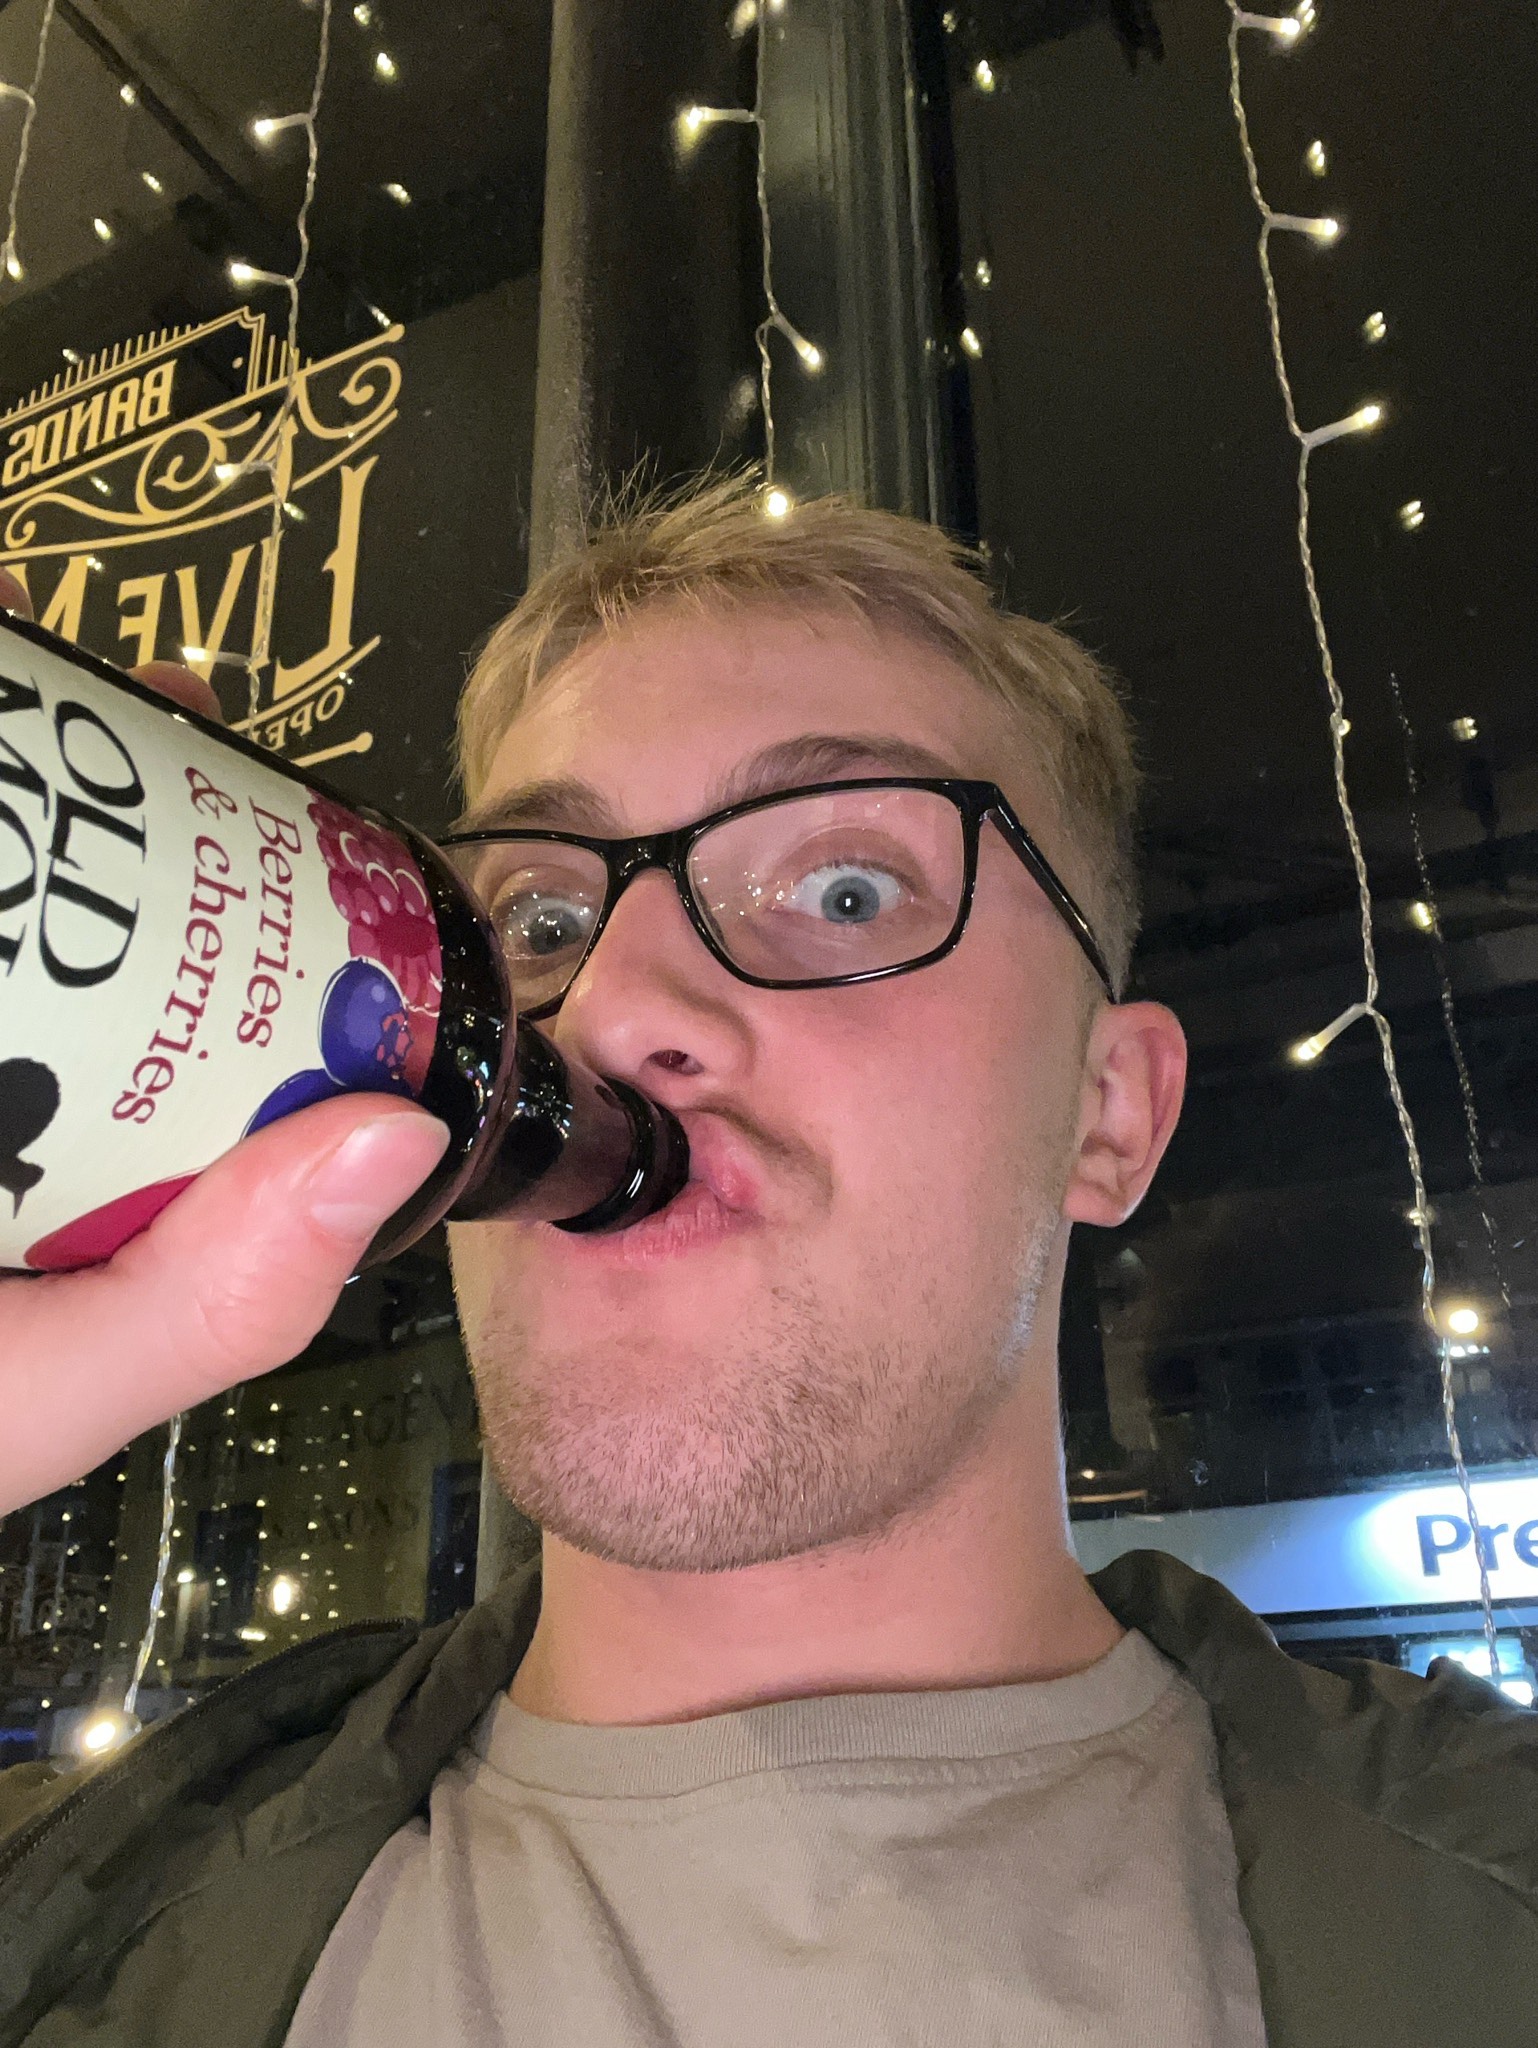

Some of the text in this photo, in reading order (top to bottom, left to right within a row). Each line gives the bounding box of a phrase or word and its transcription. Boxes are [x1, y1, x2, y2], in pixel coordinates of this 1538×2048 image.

[39, 700, 146, 988] OLD
[112, 766, 247, 1124] & cherries
[237, 796, 304, 1048] Berries
